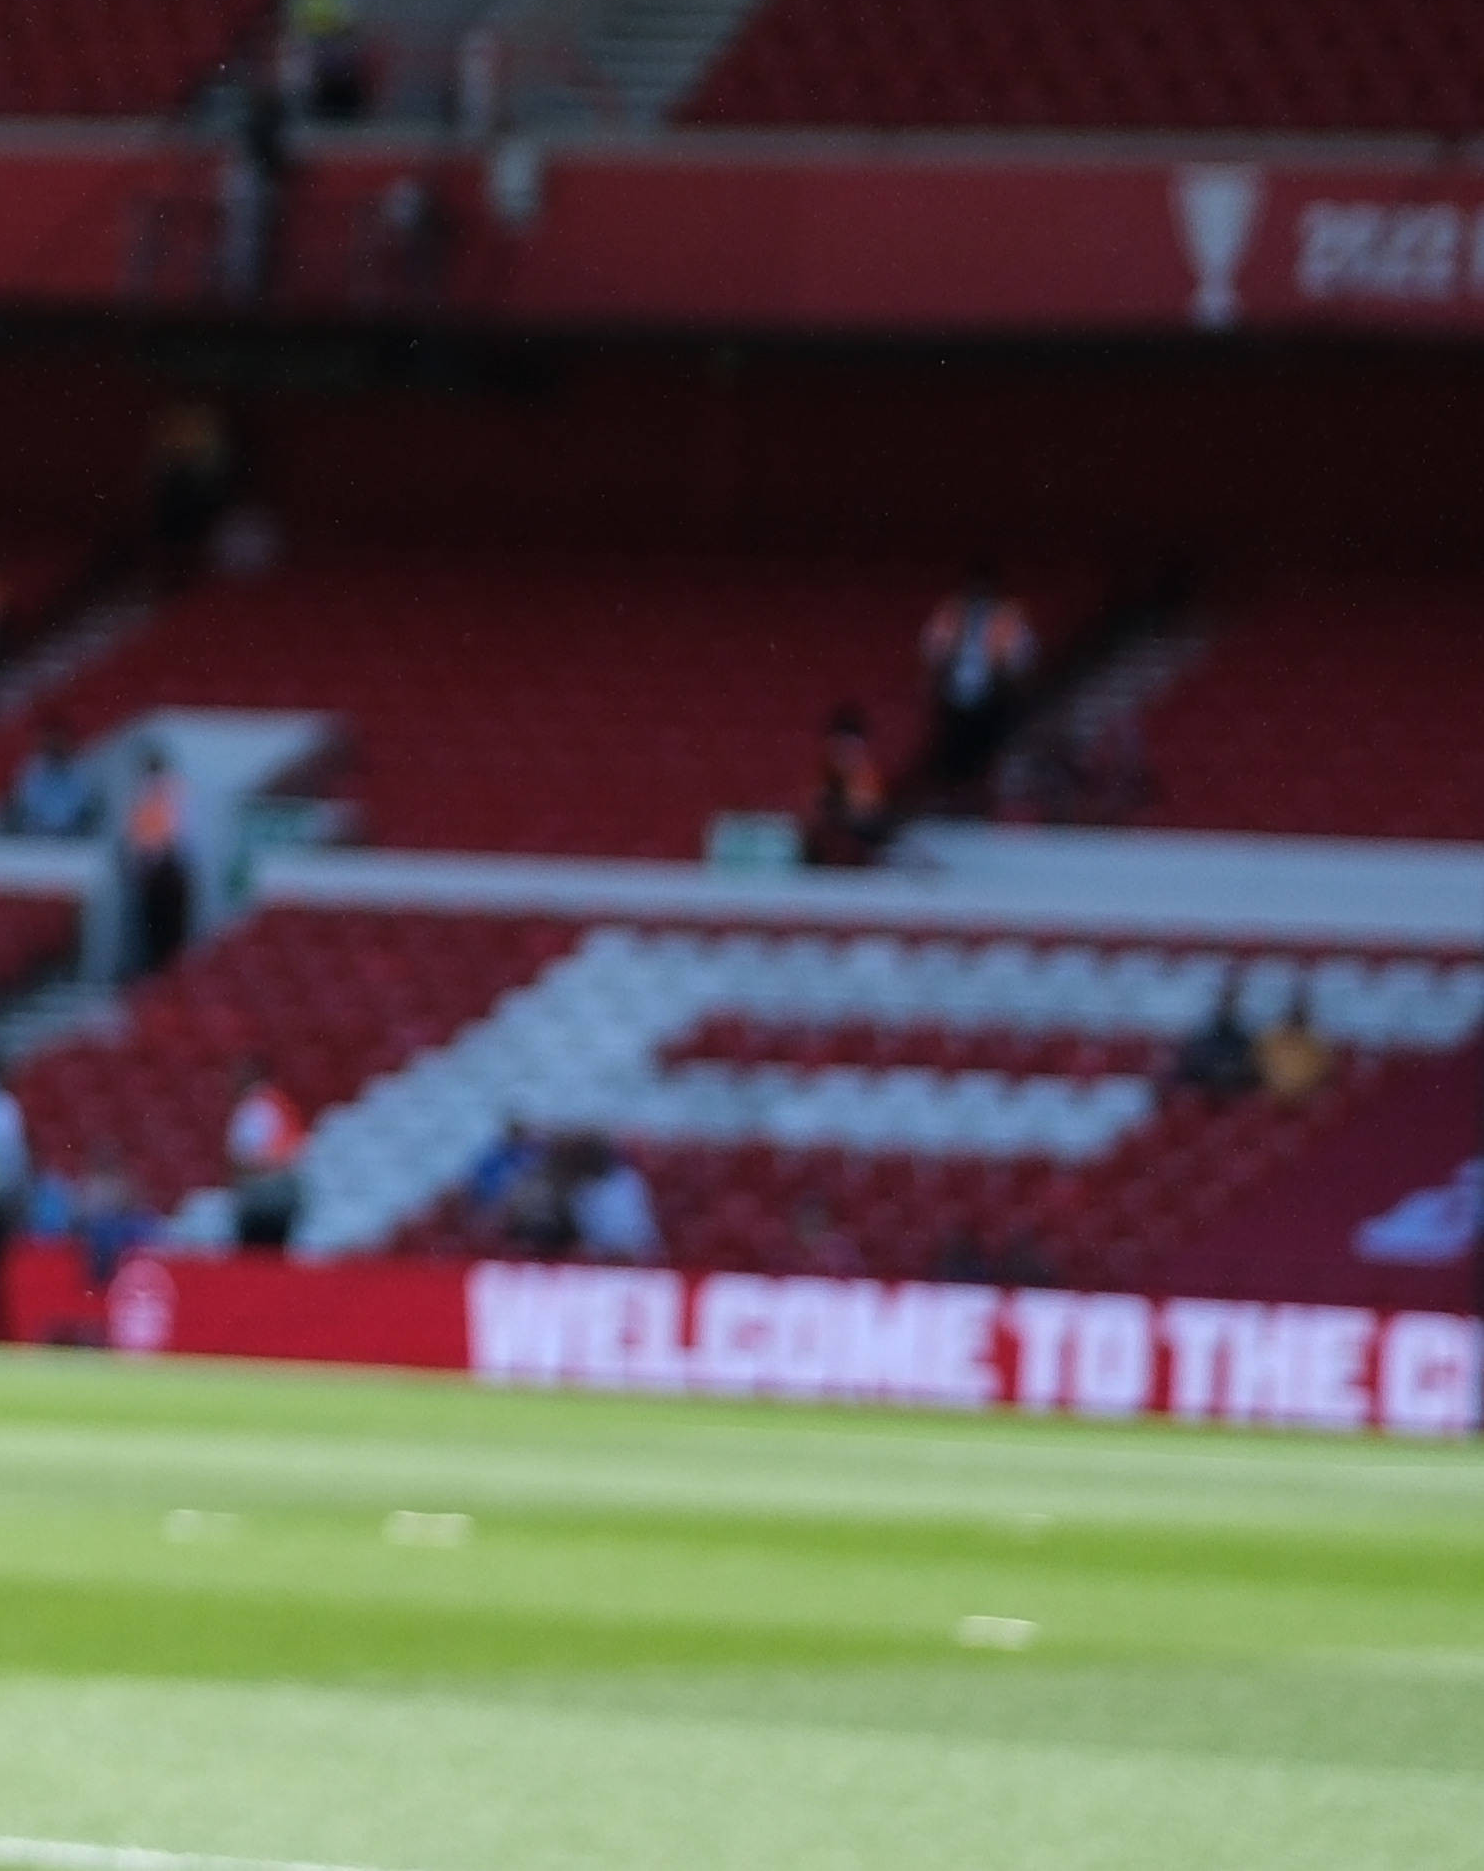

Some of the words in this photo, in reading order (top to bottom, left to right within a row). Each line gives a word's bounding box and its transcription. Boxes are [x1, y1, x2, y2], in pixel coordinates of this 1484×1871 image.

[466, 1260, 1000, 1407] WELCOME
[1006, 1287, 1151, 1414] TO
[1159, 1296, 1381, 1425] THE
